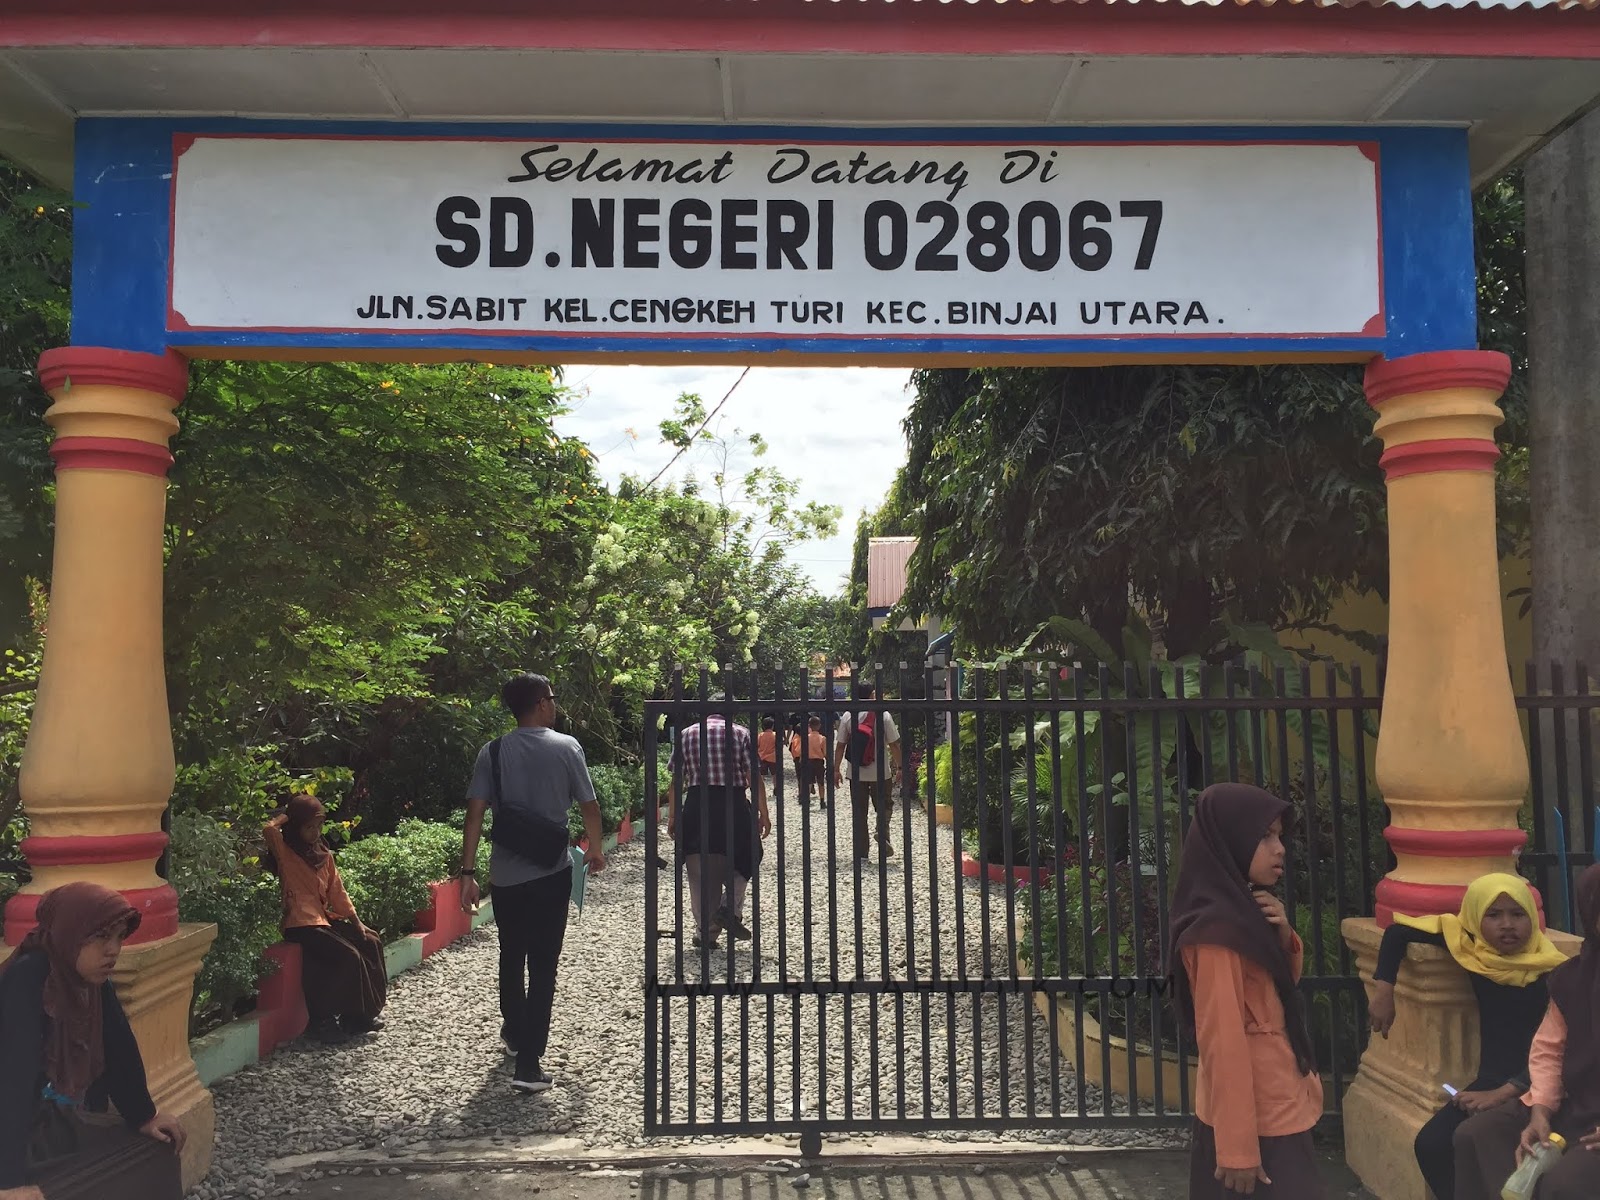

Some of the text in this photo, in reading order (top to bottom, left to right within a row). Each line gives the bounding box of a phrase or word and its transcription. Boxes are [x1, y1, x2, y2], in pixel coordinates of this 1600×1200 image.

[509, 145, 1059, 201] Selamat Datang Di
[435, 196, 1163, 272] SD.NEGERI 028067
[357, 294, 1226, 325] JLN.SABIT KEL.CENGKEH TURI KEC.BINJAI UTARA.
